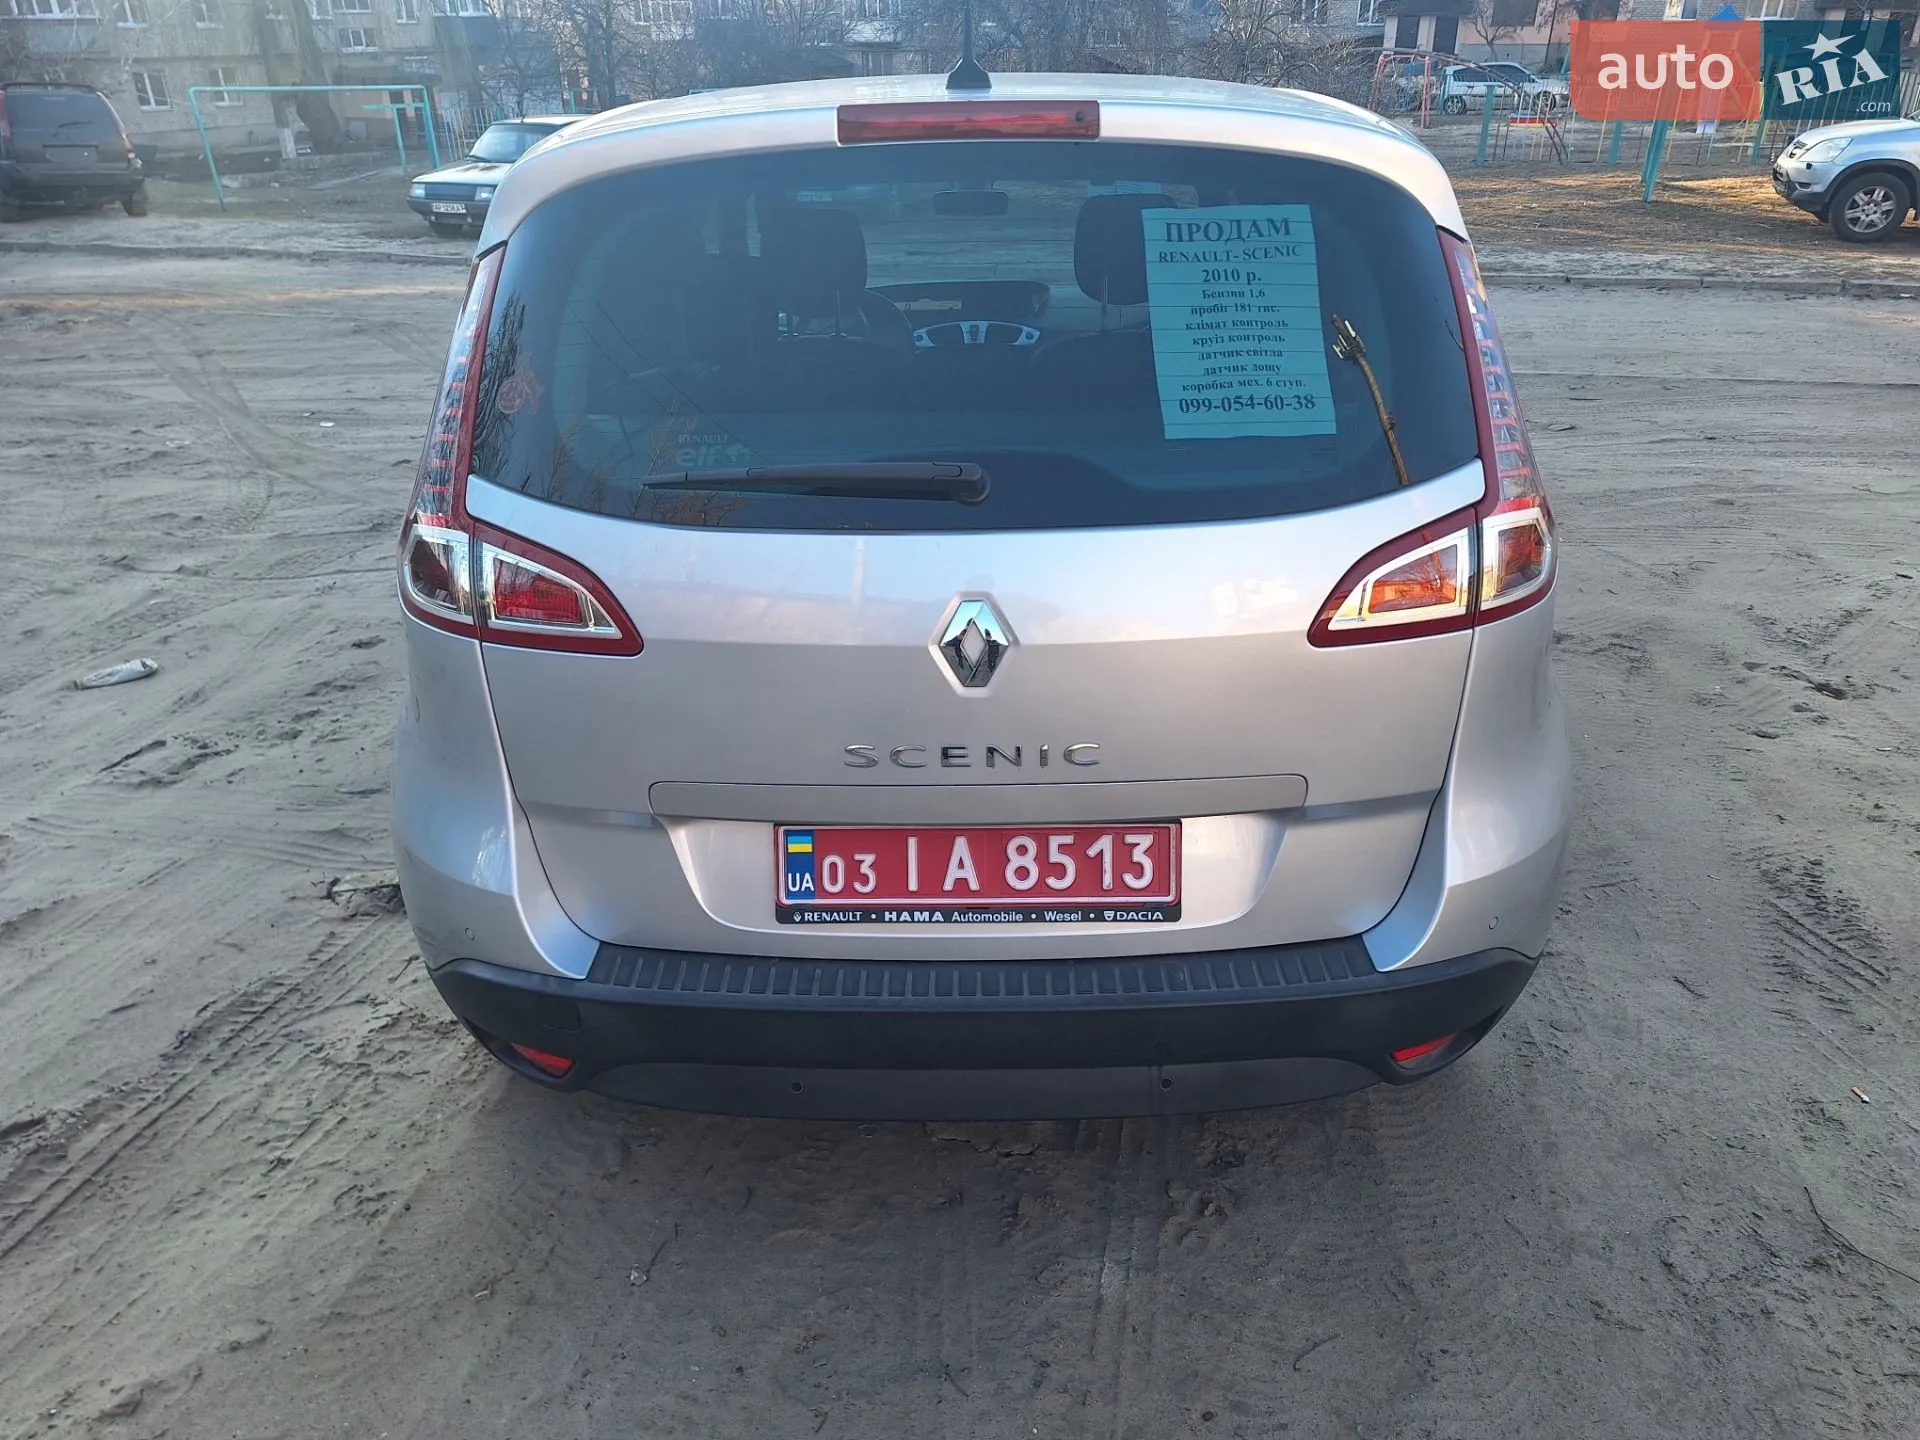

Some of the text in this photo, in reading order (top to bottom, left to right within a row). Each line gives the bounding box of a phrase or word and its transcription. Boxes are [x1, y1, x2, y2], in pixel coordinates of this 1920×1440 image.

[1165, 217, 1292, 246] ПРОДАМ
[1242, 244, 1303, 260] SCENIC
[1201, 268, 1241, 283] 2010
[1202, 288, 1266, 300] Бензин 1,6
[1190, 303, 1280, 316] пробіг 181 тис.
[1185, 318, 1289, 331] клімат контроль
[1192, 334, 1286, 347] круіз контроль
[1198, 347, 1283, 361] датчик світла
[1203, 363, 1282, 376] датчик дощу
[1182, 378, 1306, 393] коробка мех. 6 ступ.
[1179, 394, 1315, 413] 099-054-60-38
[844, 743, 1100, 768] SCENIC
[822, 834, 1155, 894] 03 IA 8513
[788, 872, 815, 892] UA
[804, 910, 1164, 923] RENAULT HAMA Automobile Wesel DACIA
